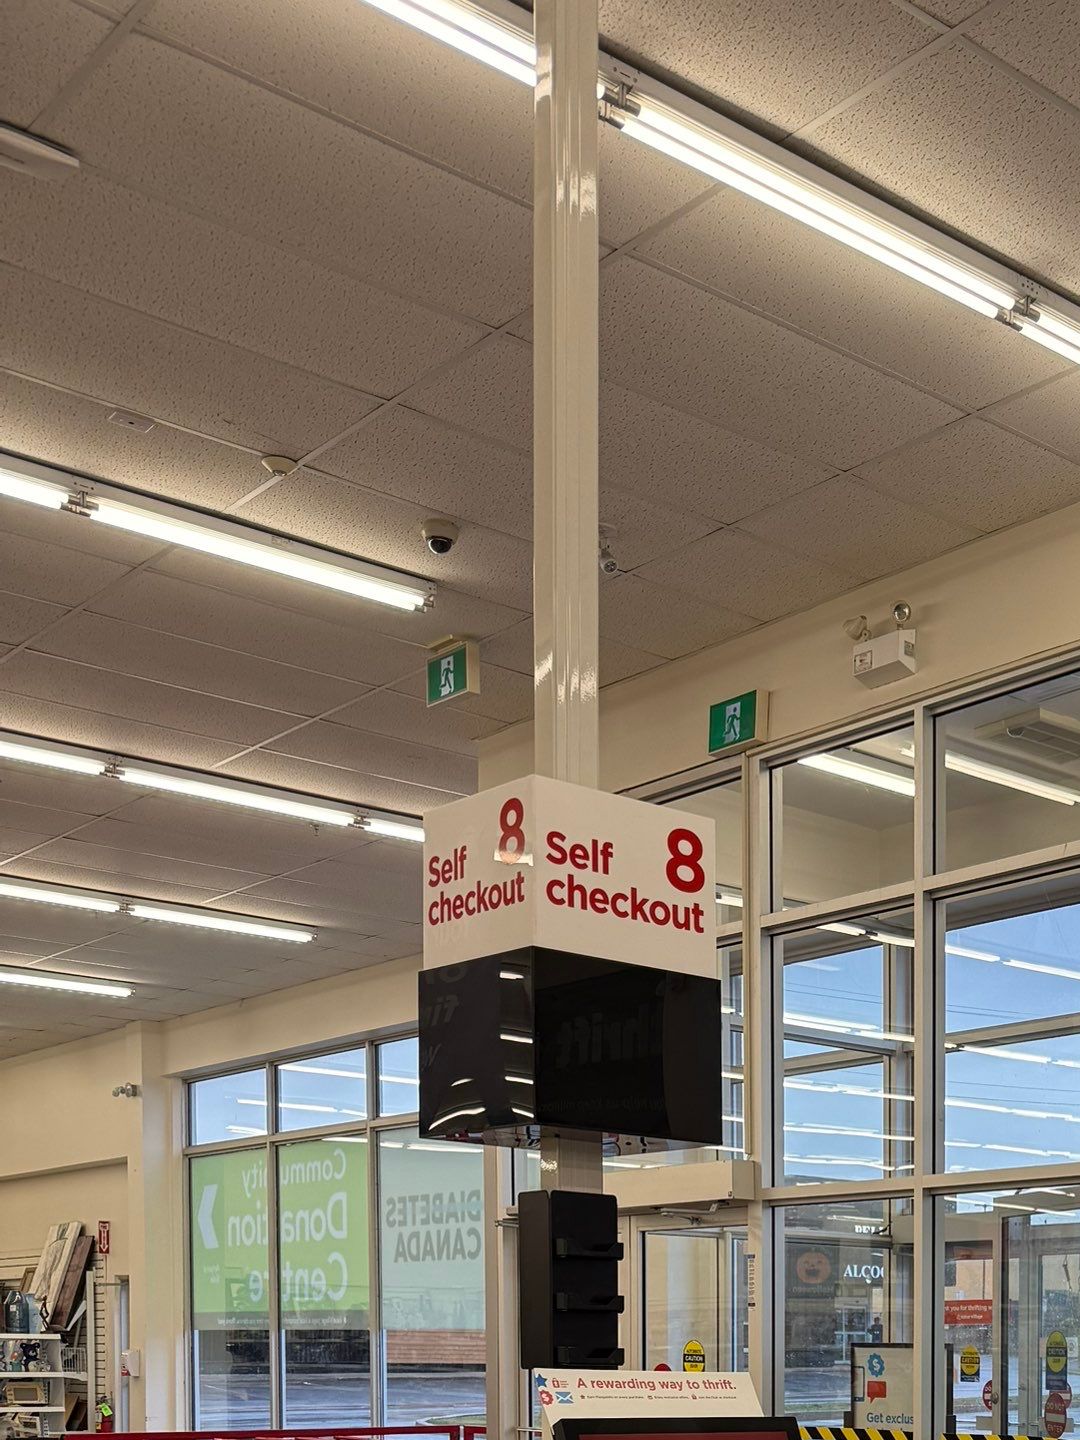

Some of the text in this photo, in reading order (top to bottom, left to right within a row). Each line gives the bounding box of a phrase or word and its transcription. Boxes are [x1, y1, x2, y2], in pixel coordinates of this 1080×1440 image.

[500, 797, 525, 865] 8
[546, 831, 613, 875] Self
[428, 845, 467, 888] Self
[666, 828, 705, 893] 8
[428, 871, 525, 926] checkout
[546, 874, 704, 934] checkout
[577, 1377, 737, 1391] A rewarding way to thrift.
[867, 1412, 883, 1423] Get
